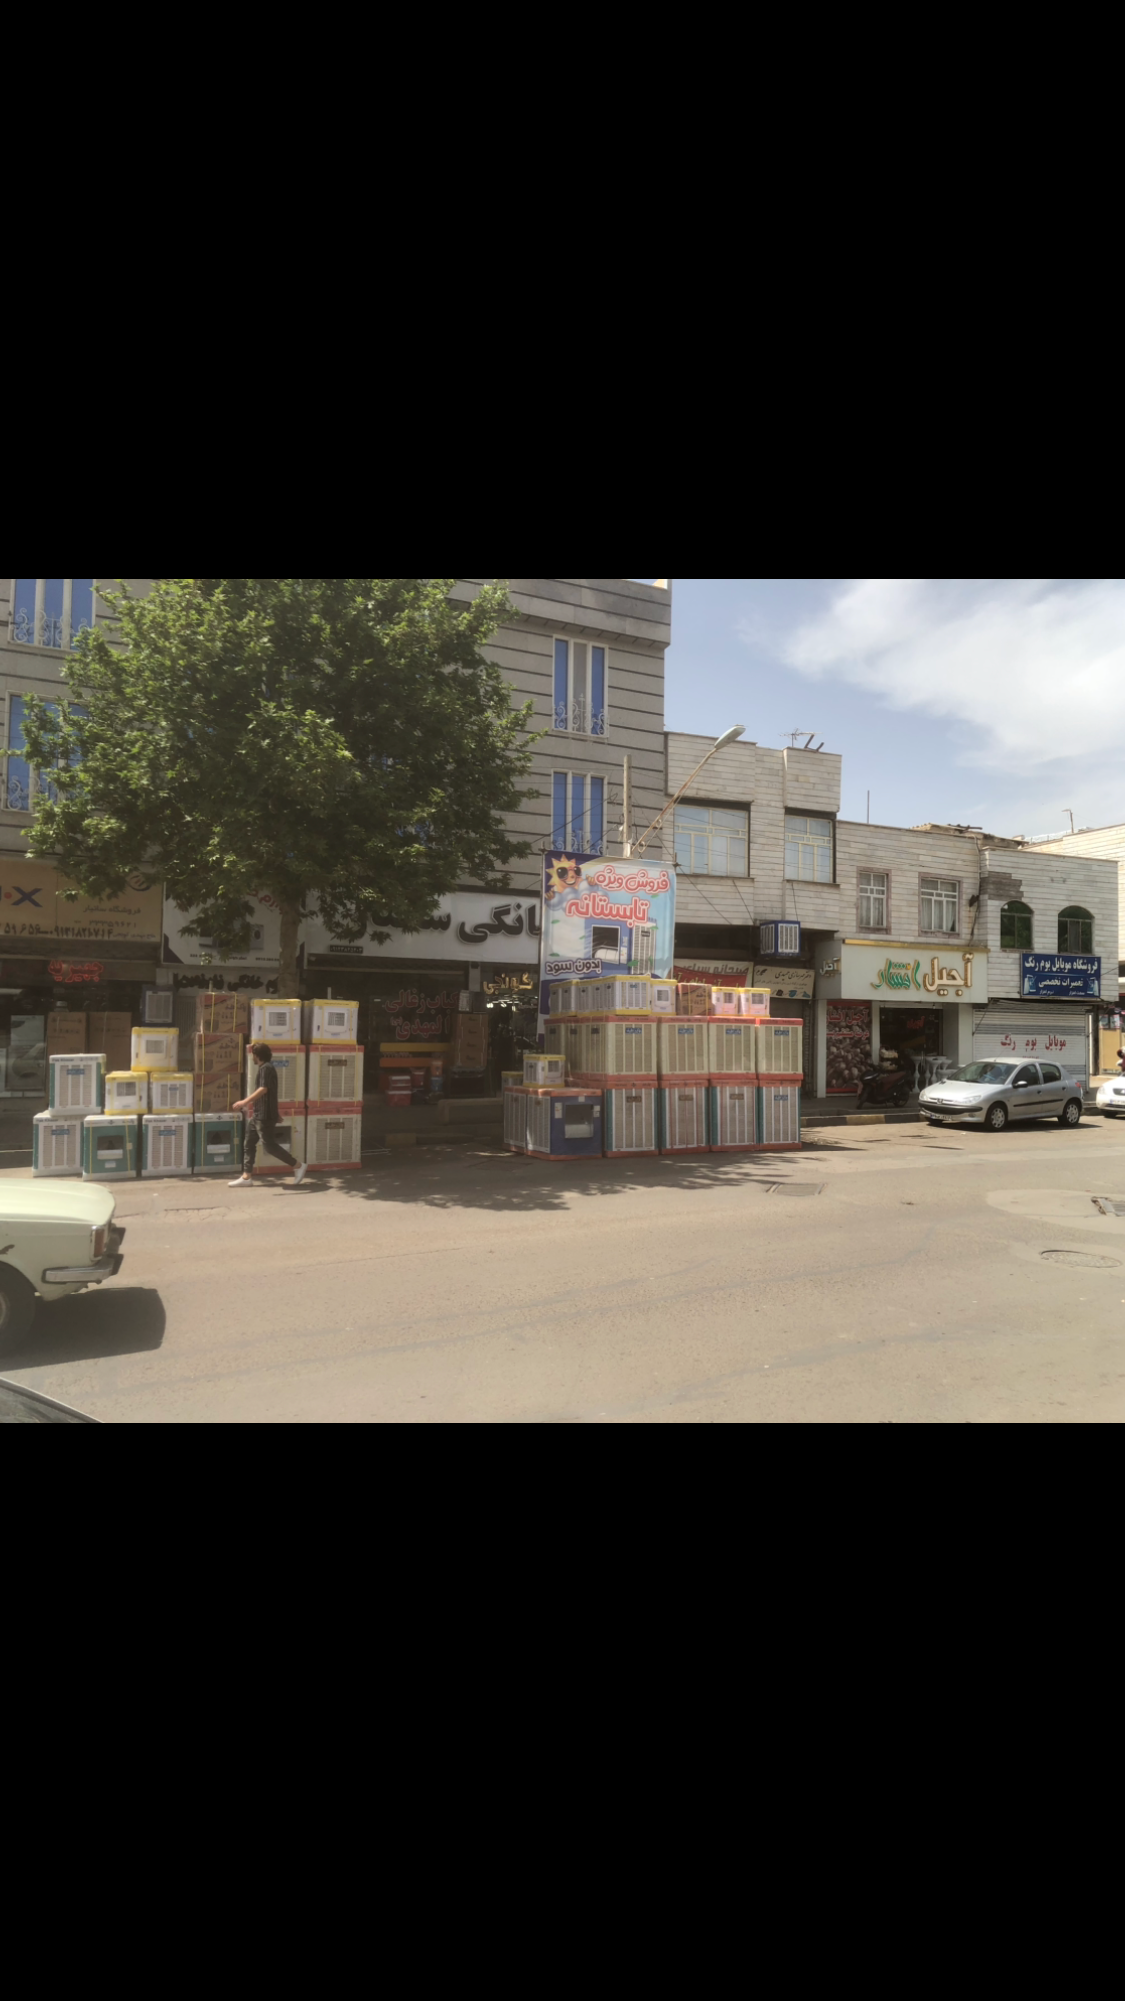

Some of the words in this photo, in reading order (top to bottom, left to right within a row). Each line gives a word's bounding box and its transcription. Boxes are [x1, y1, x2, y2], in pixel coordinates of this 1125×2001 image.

[594, 866, 625, 890] ویژه
[625, 868, 670, 895] فروش
[566, 892, 649, 928] تابستانه
[545, 960, 573, 976] سود
[574, 958, 602, 974] بدون
[1024, 956, 1040, 971] رنگ
[1040, 958, 1052, 972] بوم
[1051, 957, 1072, 973] موبایل
[1073, 958, 1098, 974] فروشگاه
[870, 958, 922, 991] افشار
[923, 953, 974, 997] آجیل
[1038, 976, 1061, 987] تخصصی
[1062, 978, 1083, 988] تعمیرات
[384, 988, 426, 1014] زغالی
[395, 1014, 450, 1040] المهدی
[1000, 1034, 1016, 1050] رنگ
[1025, 1037, 1037, 1052] بوم
[1045, 1034, 1067, 1051] موبایل
